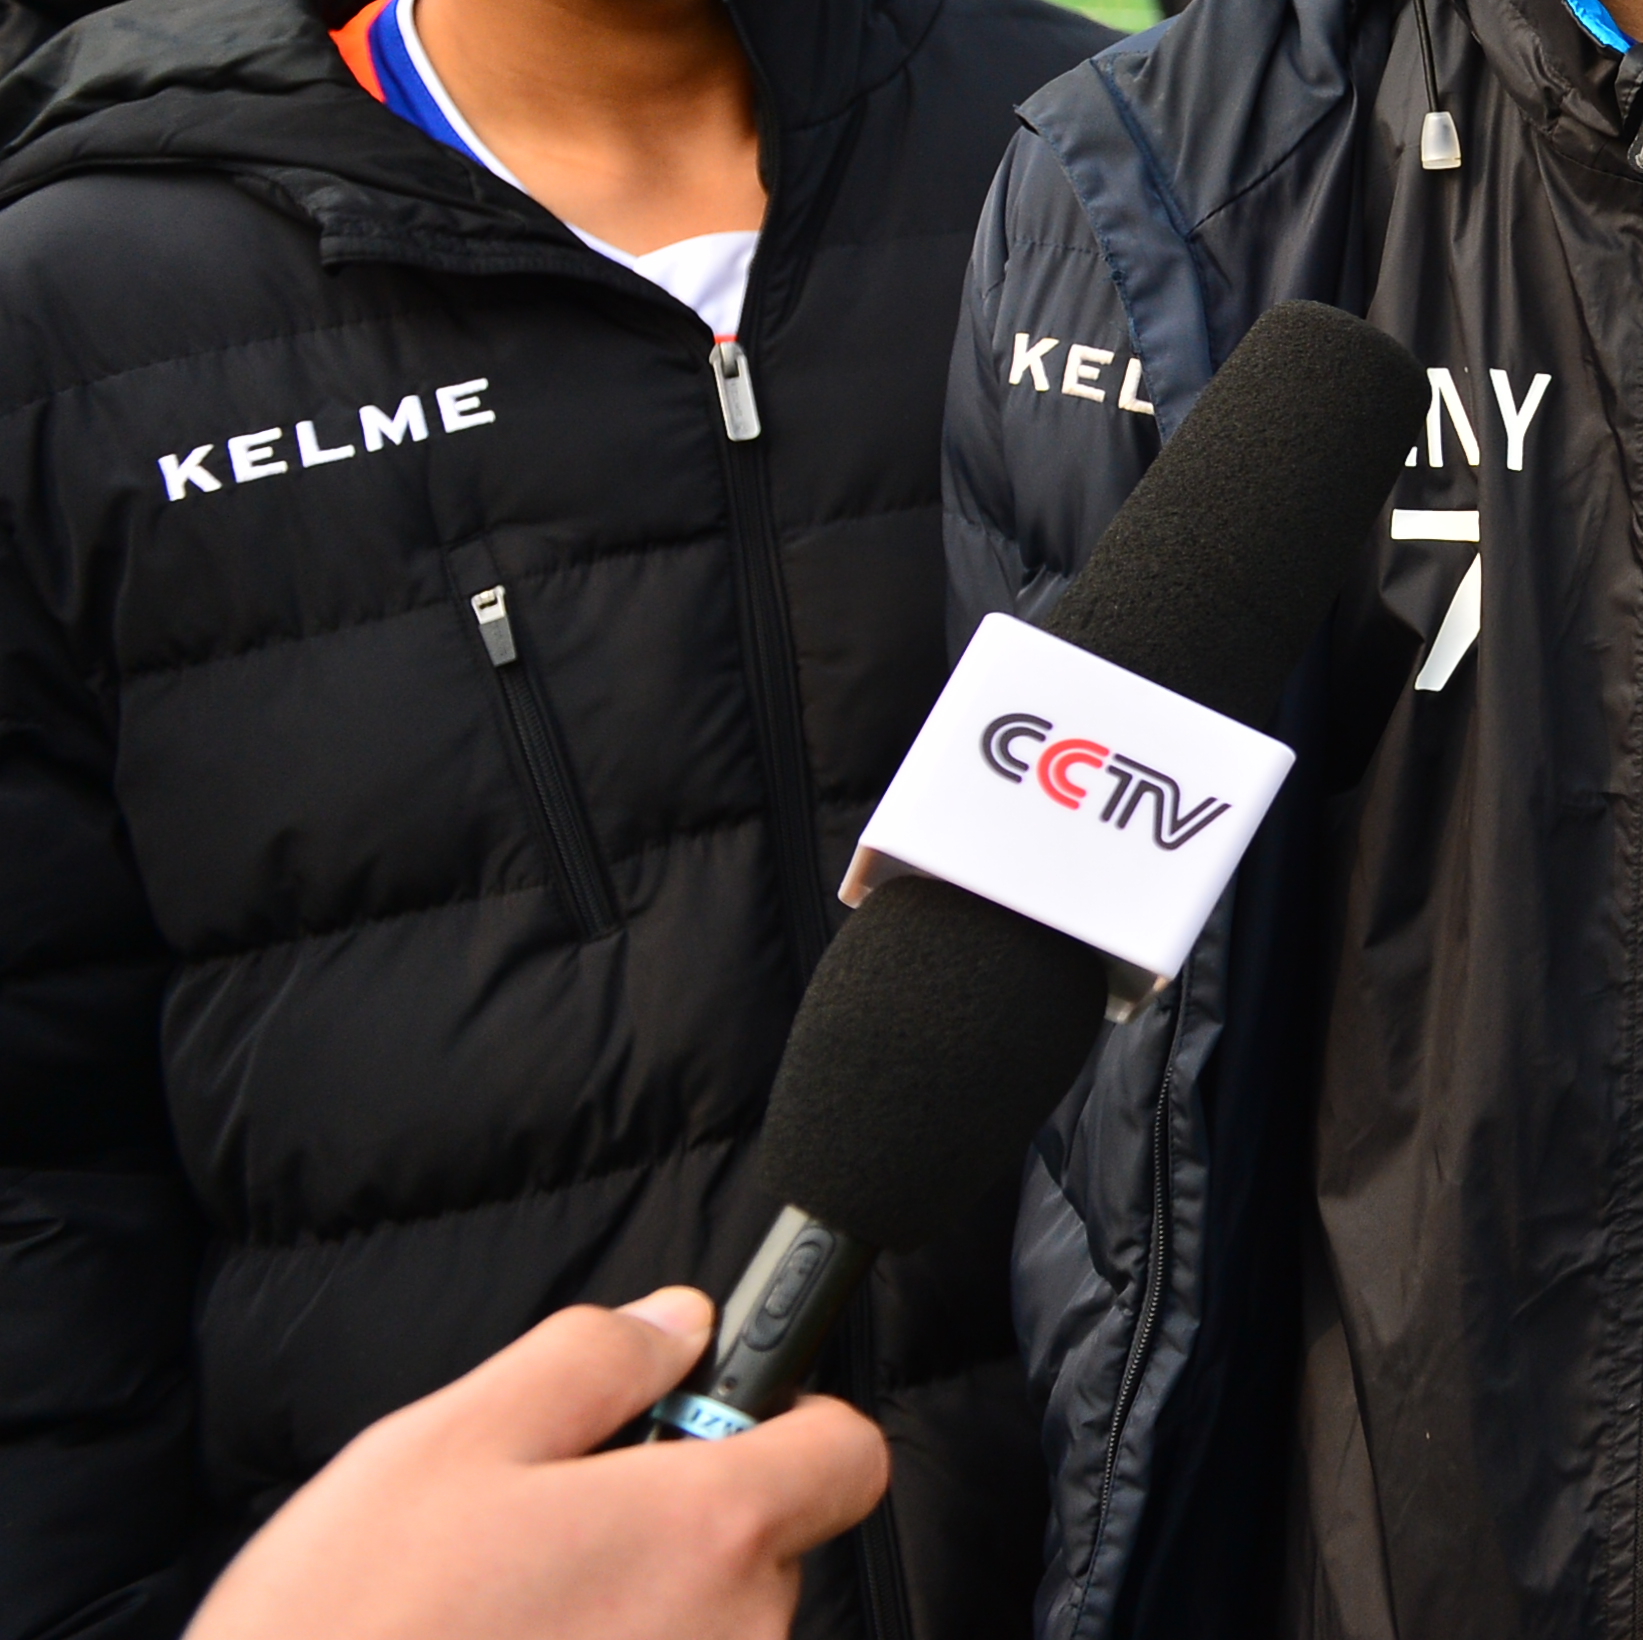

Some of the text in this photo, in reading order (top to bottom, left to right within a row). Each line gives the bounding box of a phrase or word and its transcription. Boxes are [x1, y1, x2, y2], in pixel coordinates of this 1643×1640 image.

[157, 377, 496, 502] KELME
[1404, 367, 1552, 472] NY
[1390, 508, 1482, 692] 7
[981, 712, 1231, 851] CCTV
